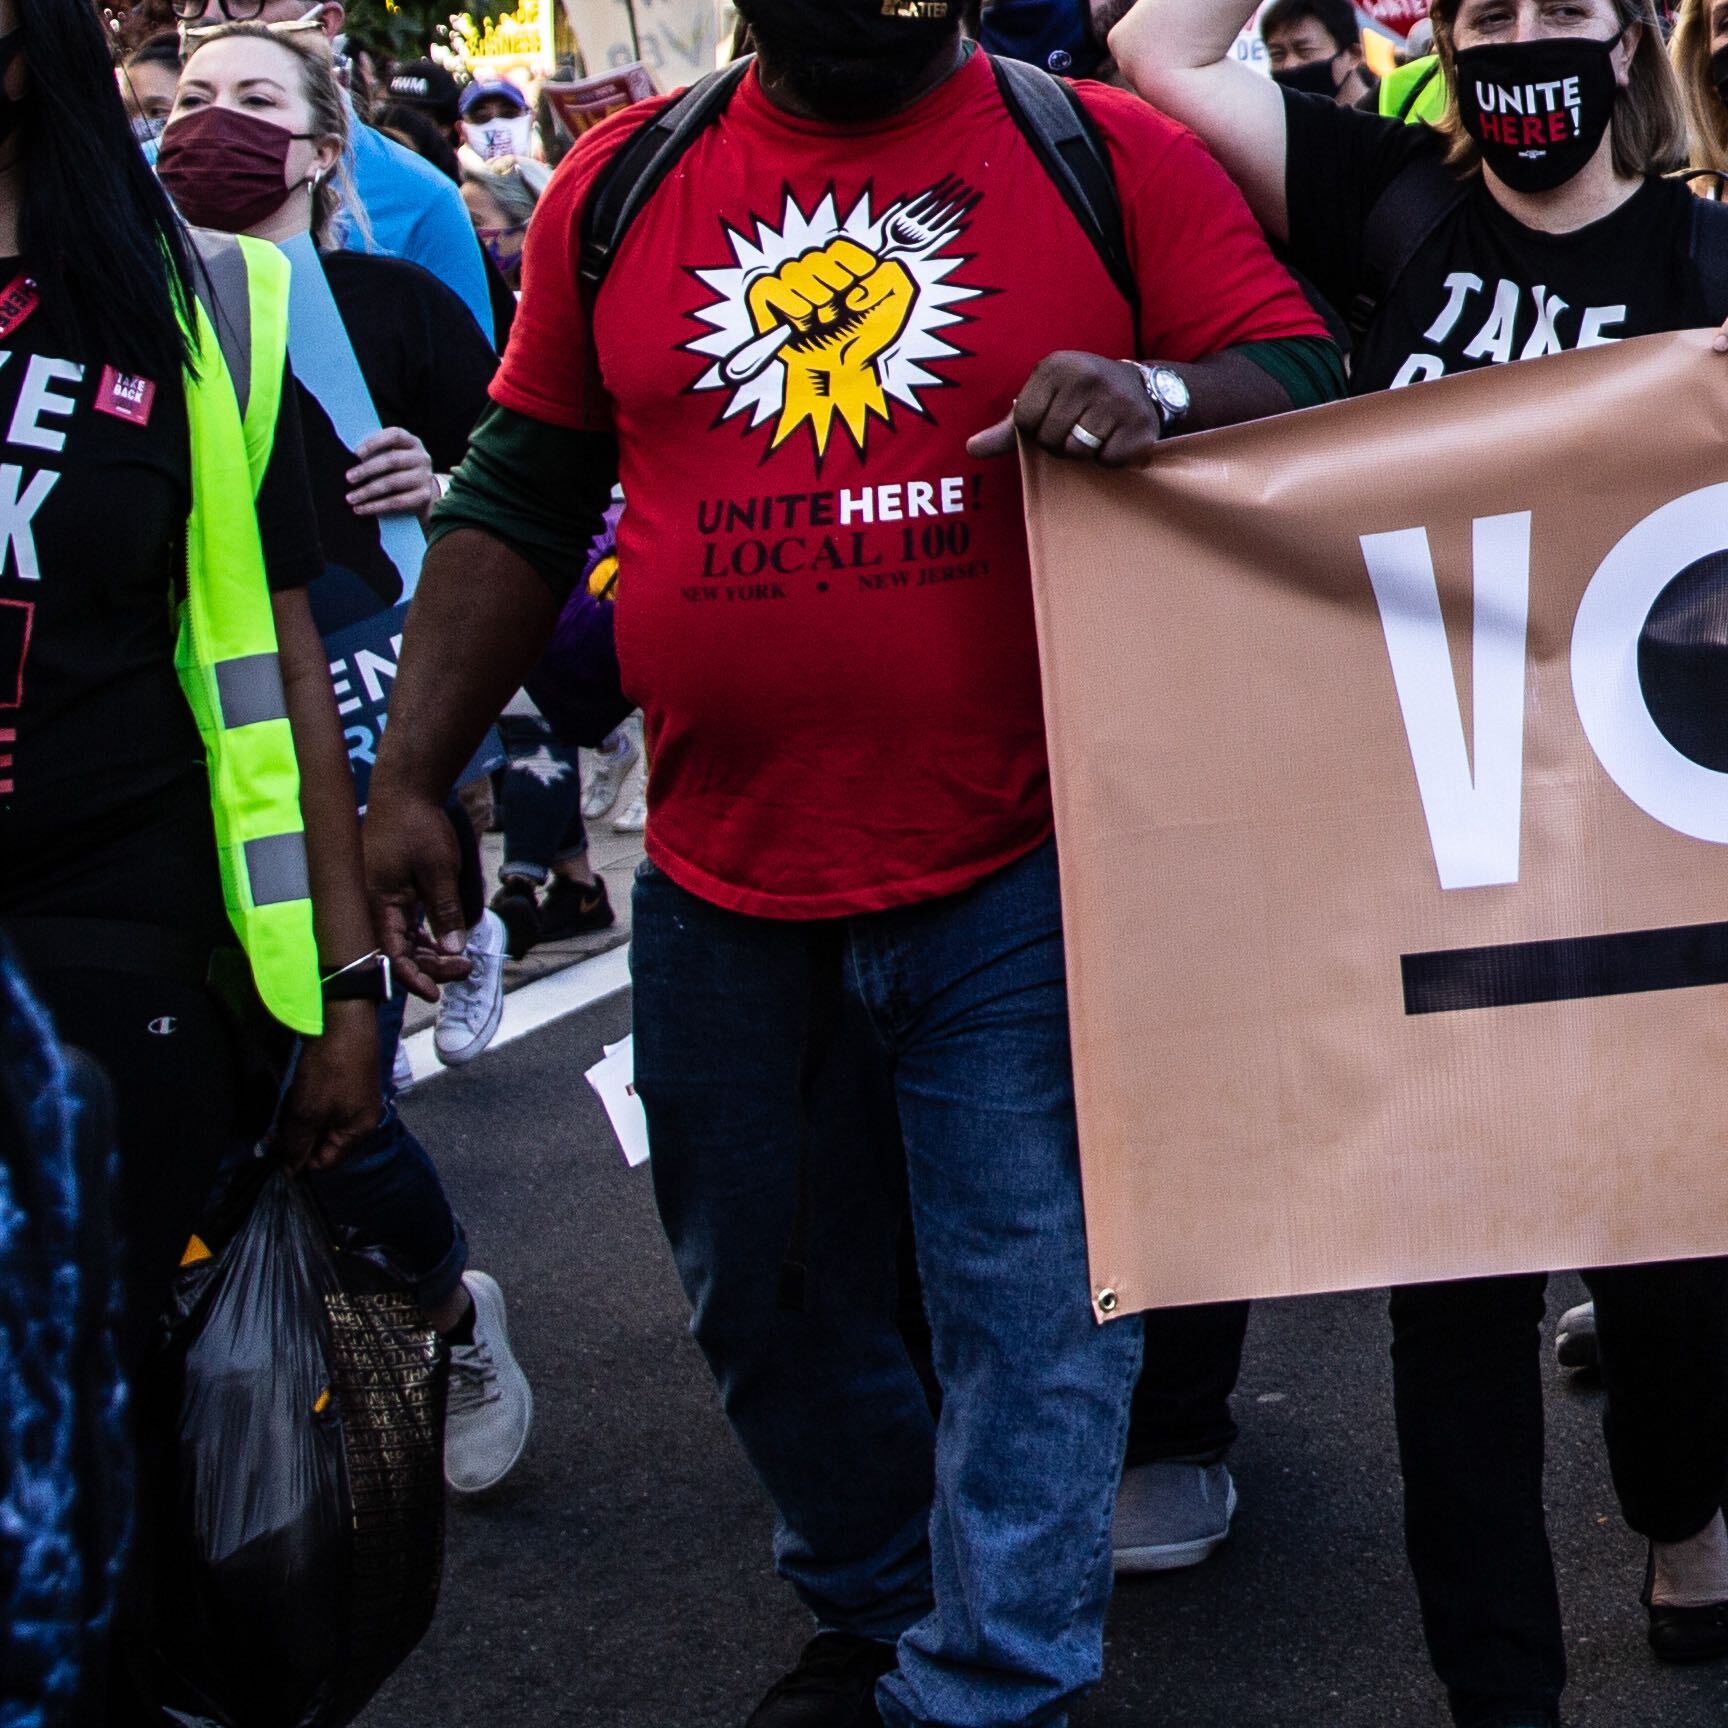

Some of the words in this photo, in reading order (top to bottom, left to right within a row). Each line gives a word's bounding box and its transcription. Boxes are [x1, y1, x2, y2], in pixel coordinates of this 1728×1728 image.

[898, 1, 948, 17] MATTER
[1475, 75, 1582, 114] UNITE
[1480, 105, 1582, 146] HERE!
[113, 384, 143, 404] BACK
[117, 372, 146, 392] TAKE
[697, 475, 982, 534] UNITEHERE!
[702, 531, 882, 577] LOCAL
[901, 521, 971, 561] 100
[681, 585, 718, 603] NEW
[725, 581, 786, 602] YORK
[858, 570, 909, 592] NEW
[916, 559, 993, 585] JERSEY
